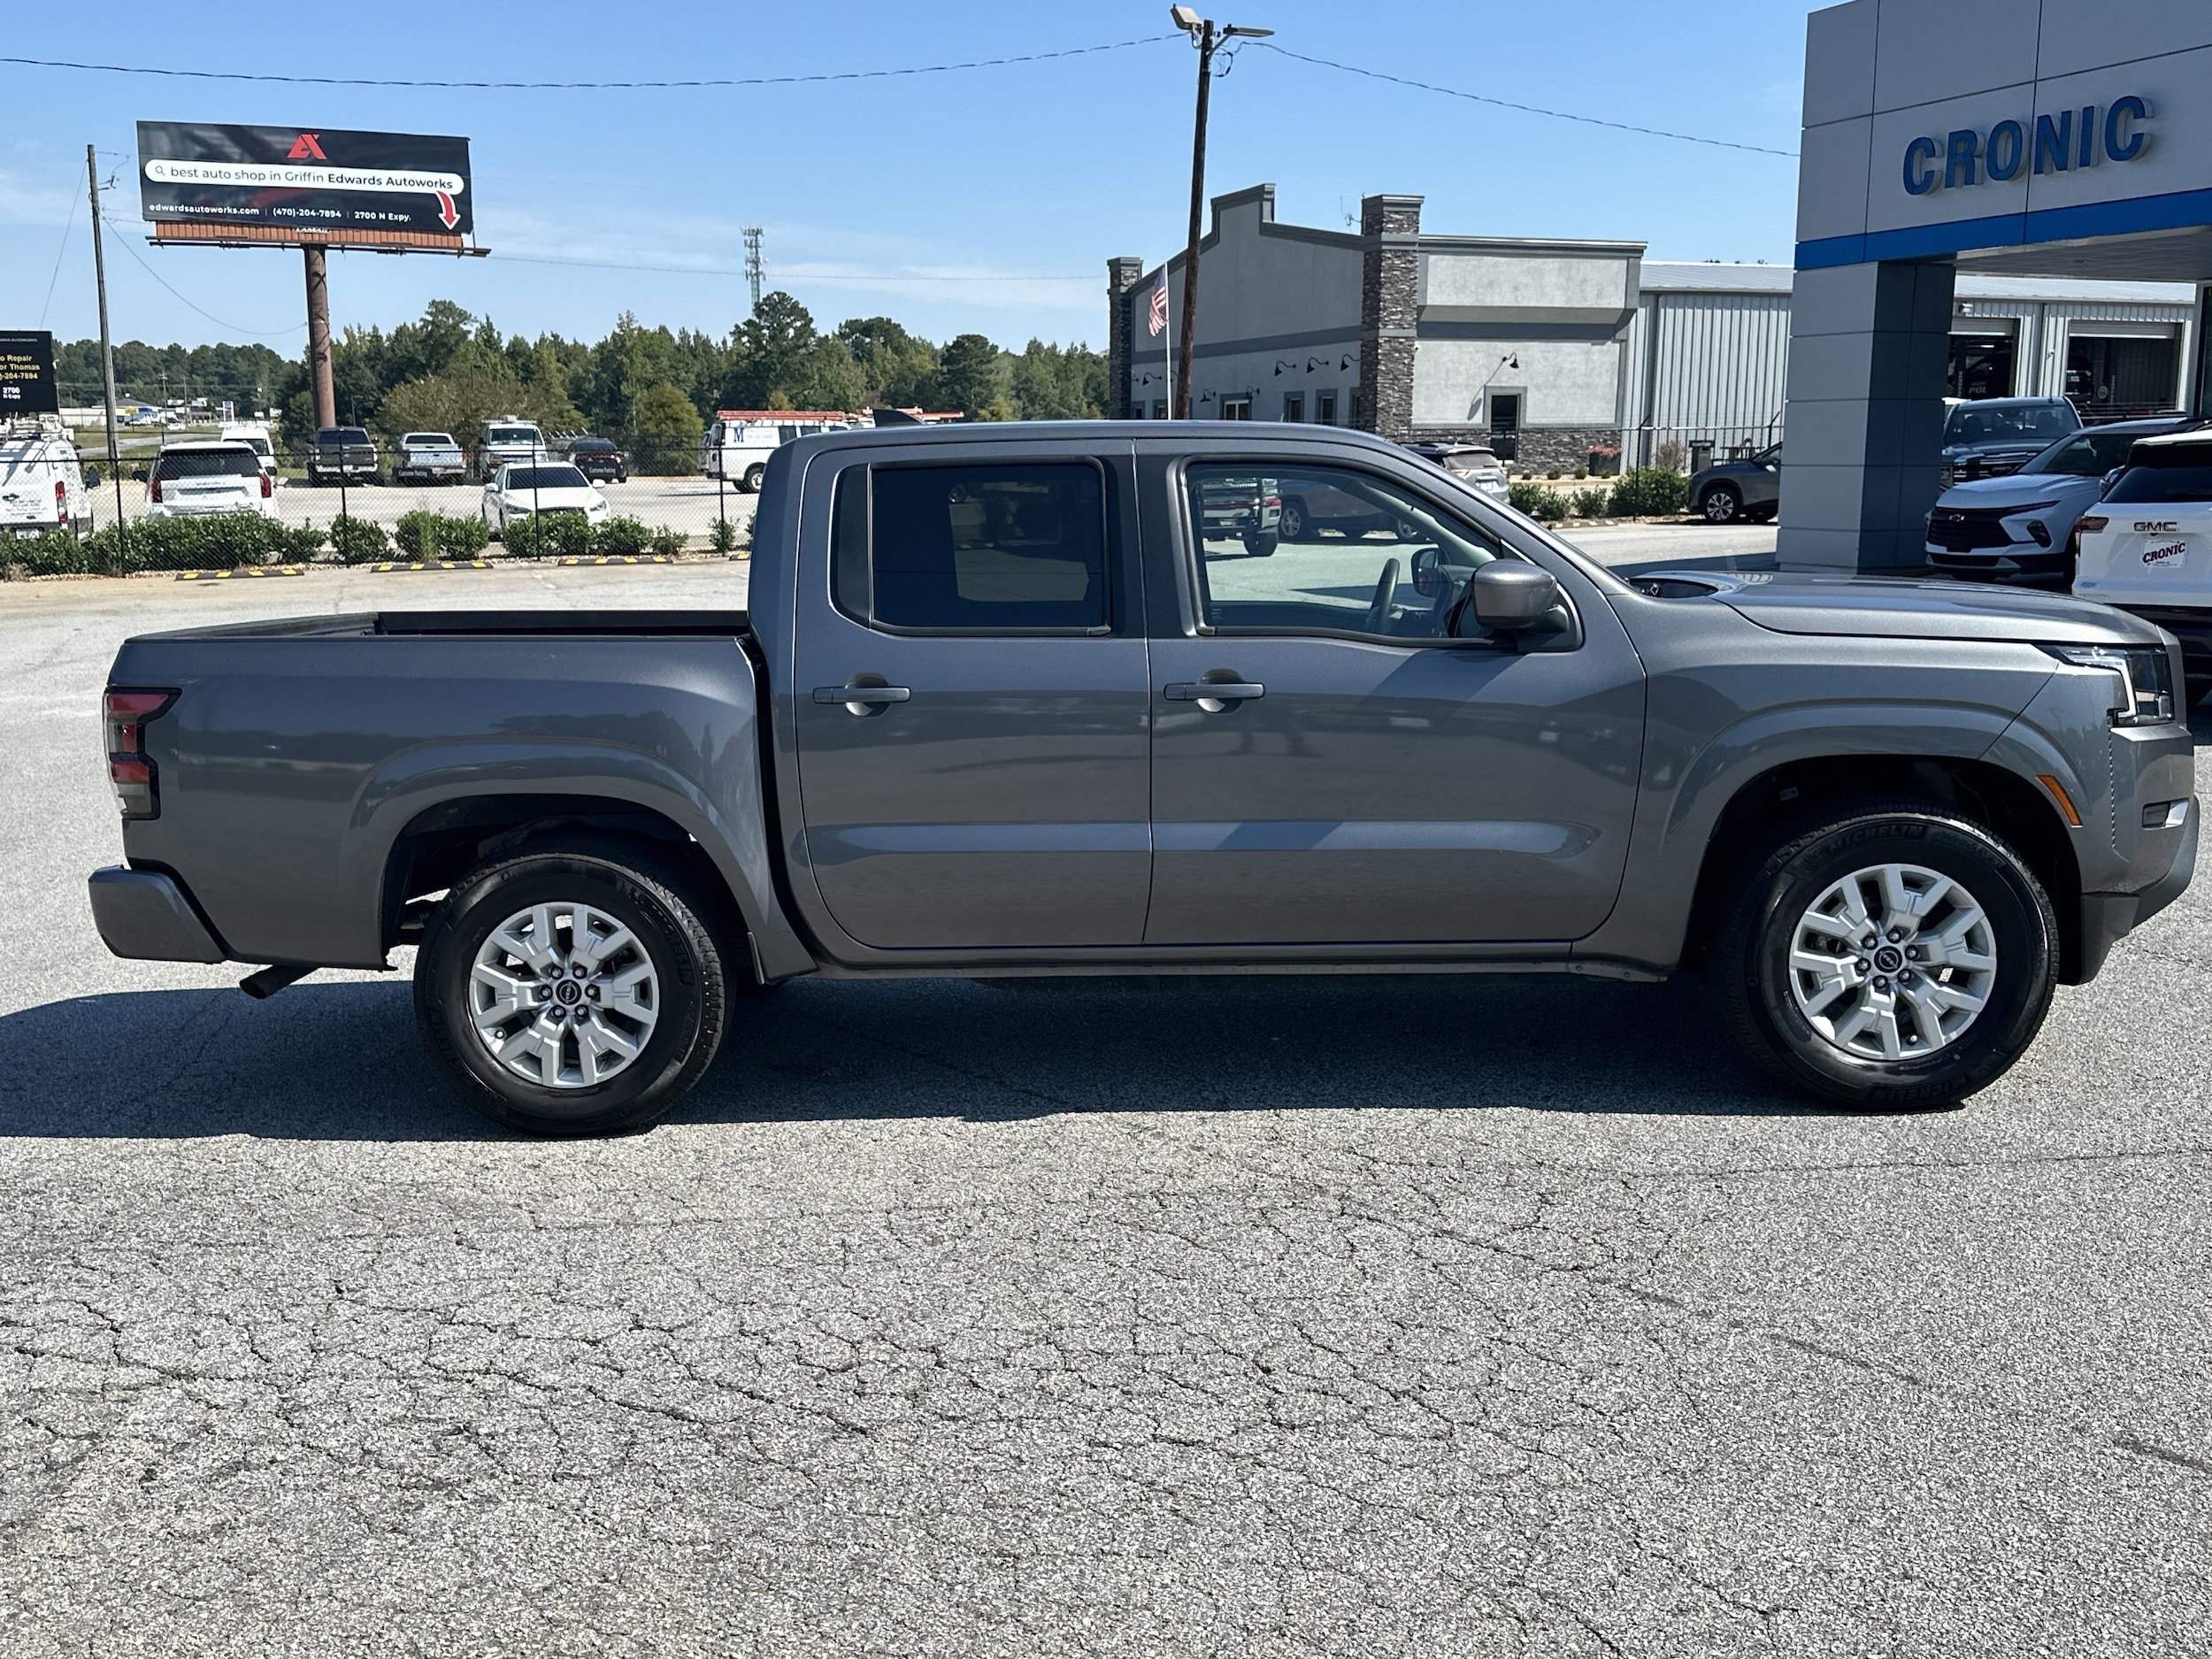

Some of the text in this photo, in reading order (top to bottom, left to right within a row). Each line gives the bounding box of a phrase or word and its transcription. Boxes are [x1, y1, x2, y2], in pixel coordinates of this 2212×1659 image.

[1903, 95, 2152, 196] CRONIC
[171, 166, 453, 189] best auto shop in Griffin Edwards Autoworks
[149, 204, 412, 222] edwardsautoworks.com (470)-204-7894 2700 N Expy.
[2133, 521, 2177, 532] GMC
[2142, 542, 2186, 564] CRONIC
